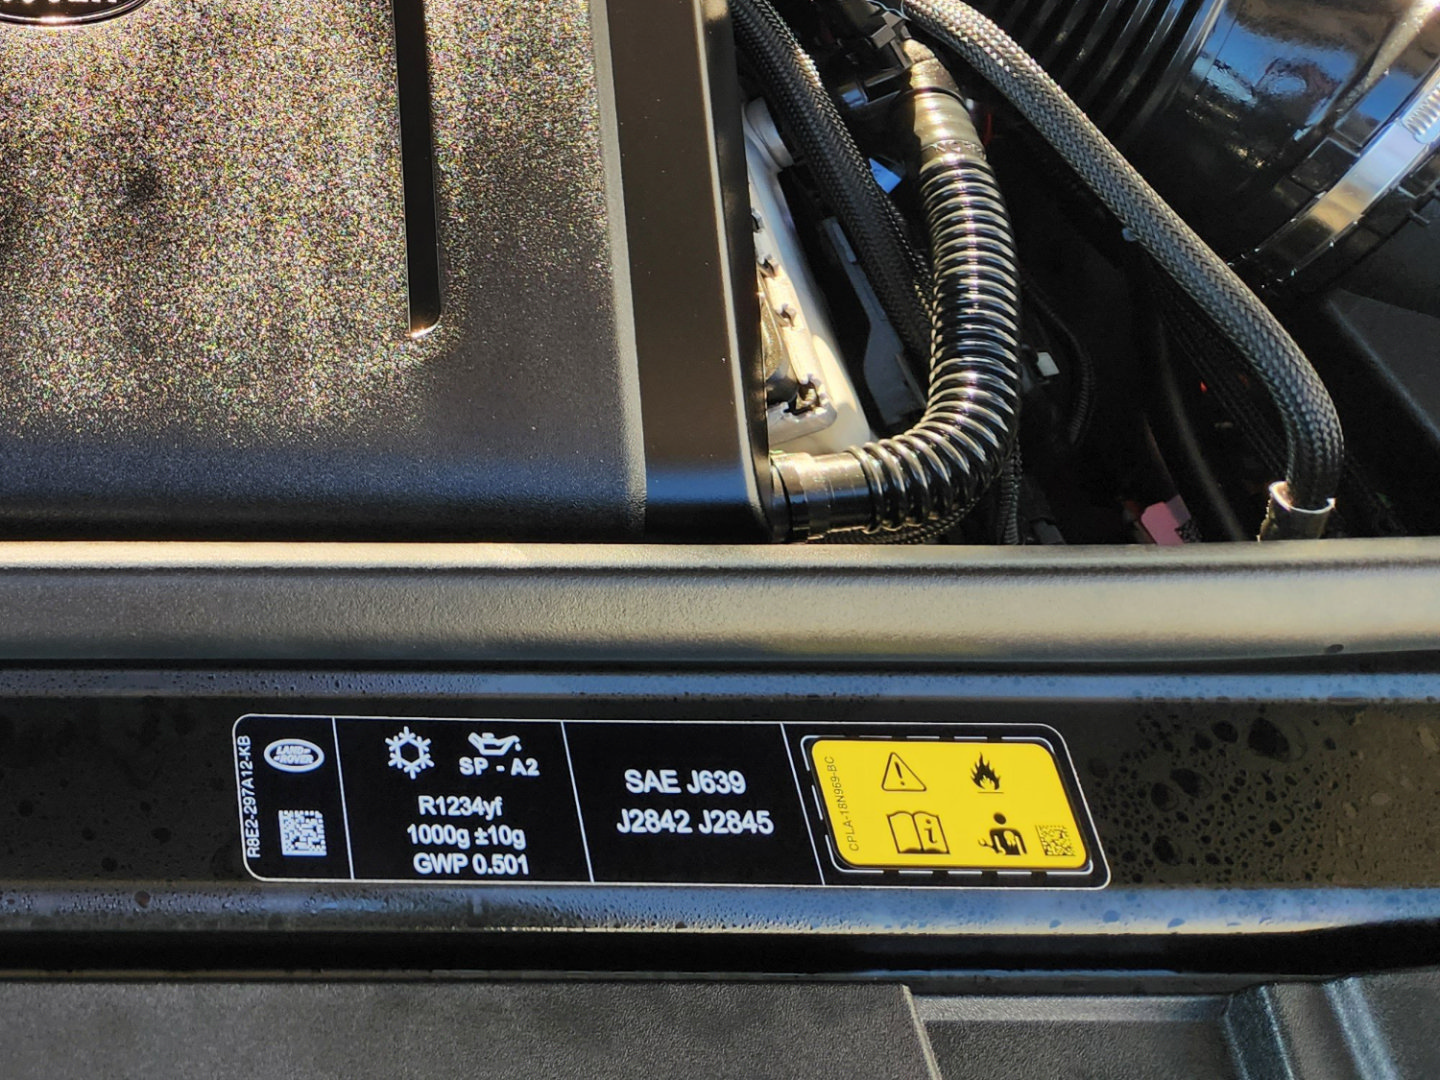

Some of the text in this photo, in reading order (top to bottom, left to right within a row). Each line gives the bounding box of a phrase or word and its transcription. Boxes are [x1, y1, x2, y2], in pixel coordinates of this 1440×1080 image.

[276, 746, 303, 754] LAND
[279, 754, 314, 764] ROVER
[459, 757, 489, 776] SP
[510, 758, 540, 777] A2
[624, 769, 747, 794] SAE J639
[237, 735, 261, 858] R8E2-297A12-KB
[418, 795, 503, 820] R1234yf
[824, 756, 860, 852] CPLA-18N969-BC
[616, 808, 774, 835] J2842 J2845
[407, 824, 471, 849] 1000g
[413, 853, 529, 875] GWP 0.501
